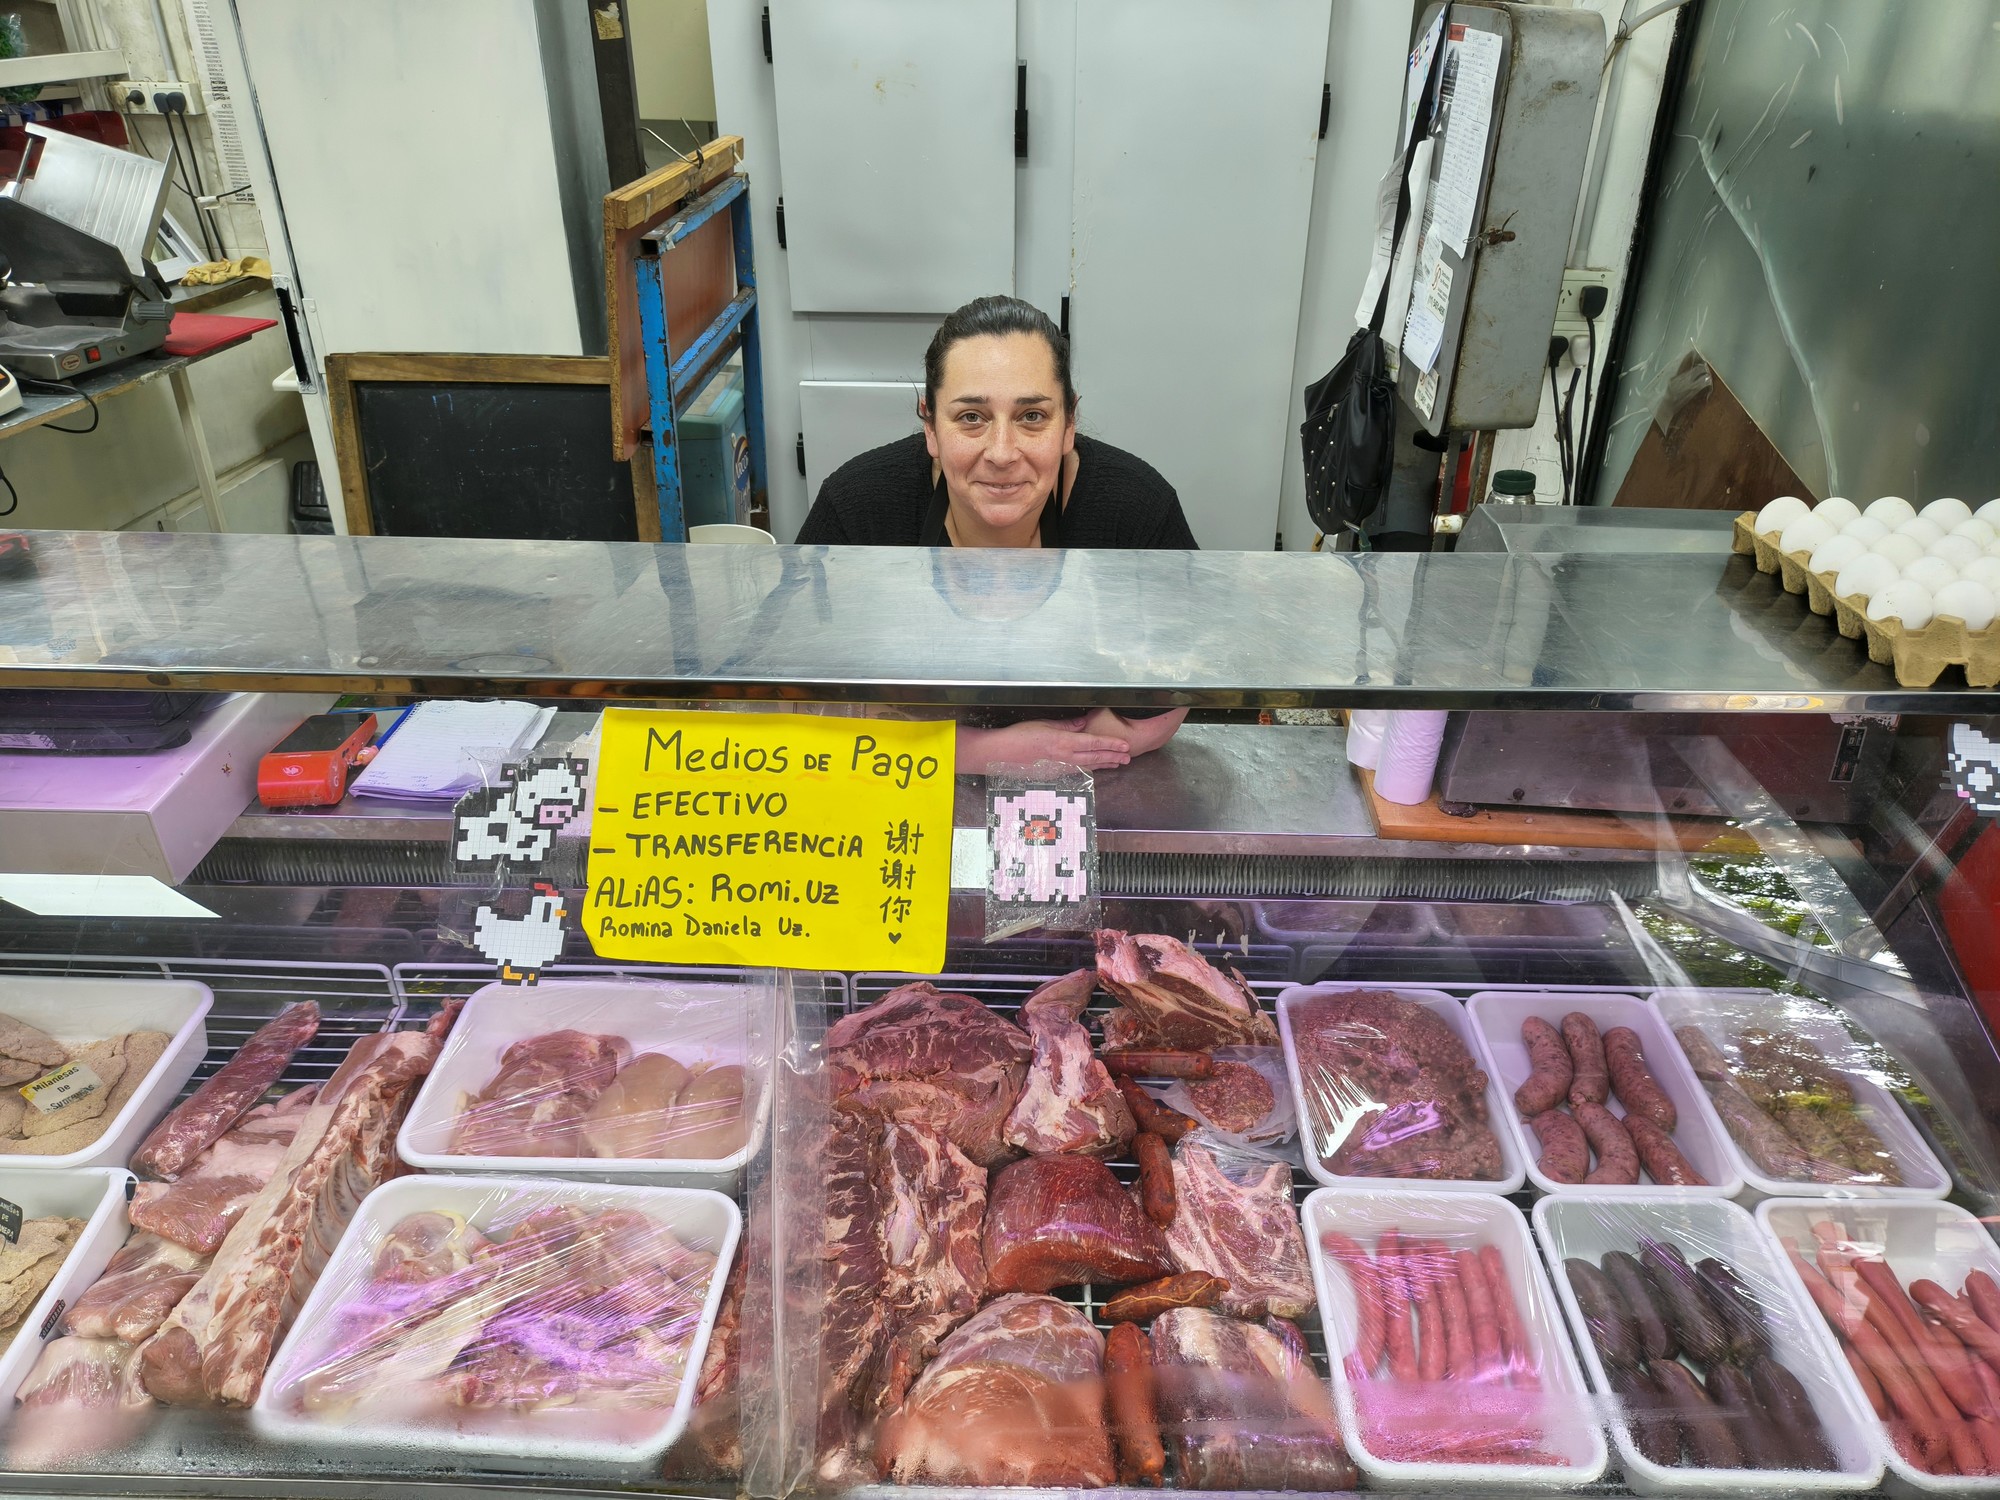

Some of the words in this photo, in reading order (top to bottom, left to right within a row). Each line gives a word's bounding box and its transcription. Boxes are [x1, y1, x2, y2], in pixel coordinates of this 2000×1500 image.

[645, 728, 788, 773] Medios
[804, 754, 831, 771] DE
[852, 735, 938, 789] Pago
[880, 819, 924, 923] 谢谢你
[600, 916, 672, 938] Romina
[683, 913, 761, 937] Daniela
[779, 917, 809, 937] Uz.
[32, 1065, 79, 1092] Milanesas
[57, 1083, 71, 1093] De
